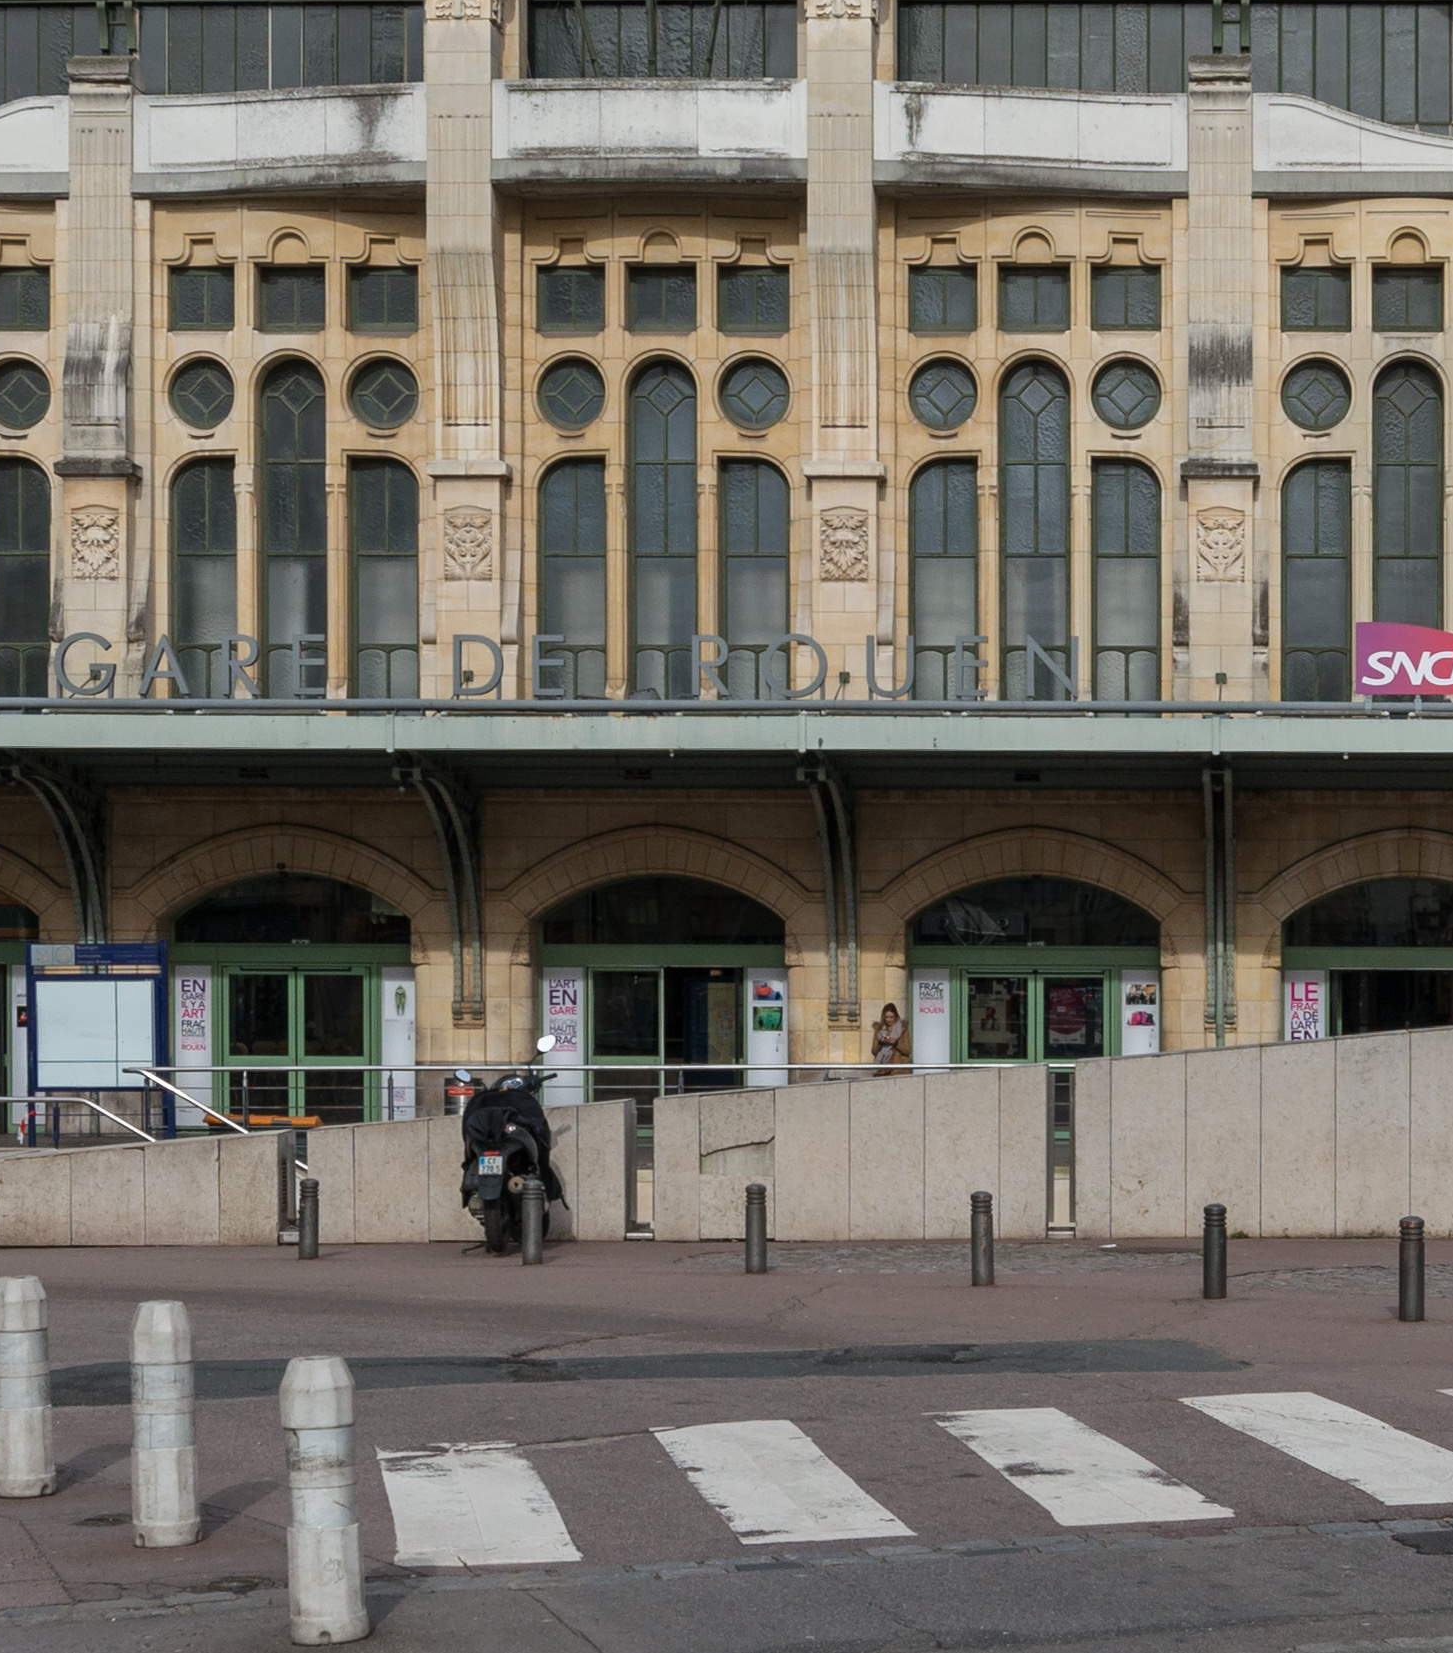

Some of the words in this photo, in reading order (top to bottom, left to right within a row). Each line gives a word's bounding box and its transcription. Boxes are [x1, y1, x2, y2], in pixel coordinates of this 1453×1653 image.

[53, 632, 327, 696] GARE
[452, 634, 565, 696] DE
[691, 634, 1079, 698] ROUEN
[181, 979, 205, 992] EN
[549, 979, 577, 988] L'ART
[919, 982, 944, 990] FRAC
[1290, 981, 1319, 1001] LE
[549, 989, 577, 1005] EN
[549, 1006, 577, 1015] GARE
[1291, 1002, 1318, 1011] FRAC
[182, 1009, 206, 1018] ART
[1303, 1011, 1318, 1020] DE
[181, 1020, 206, 1028] FRAC
[1291, 1020, 1318, 1029] L'ART
[555, 1036, 577, 1044] RAC
